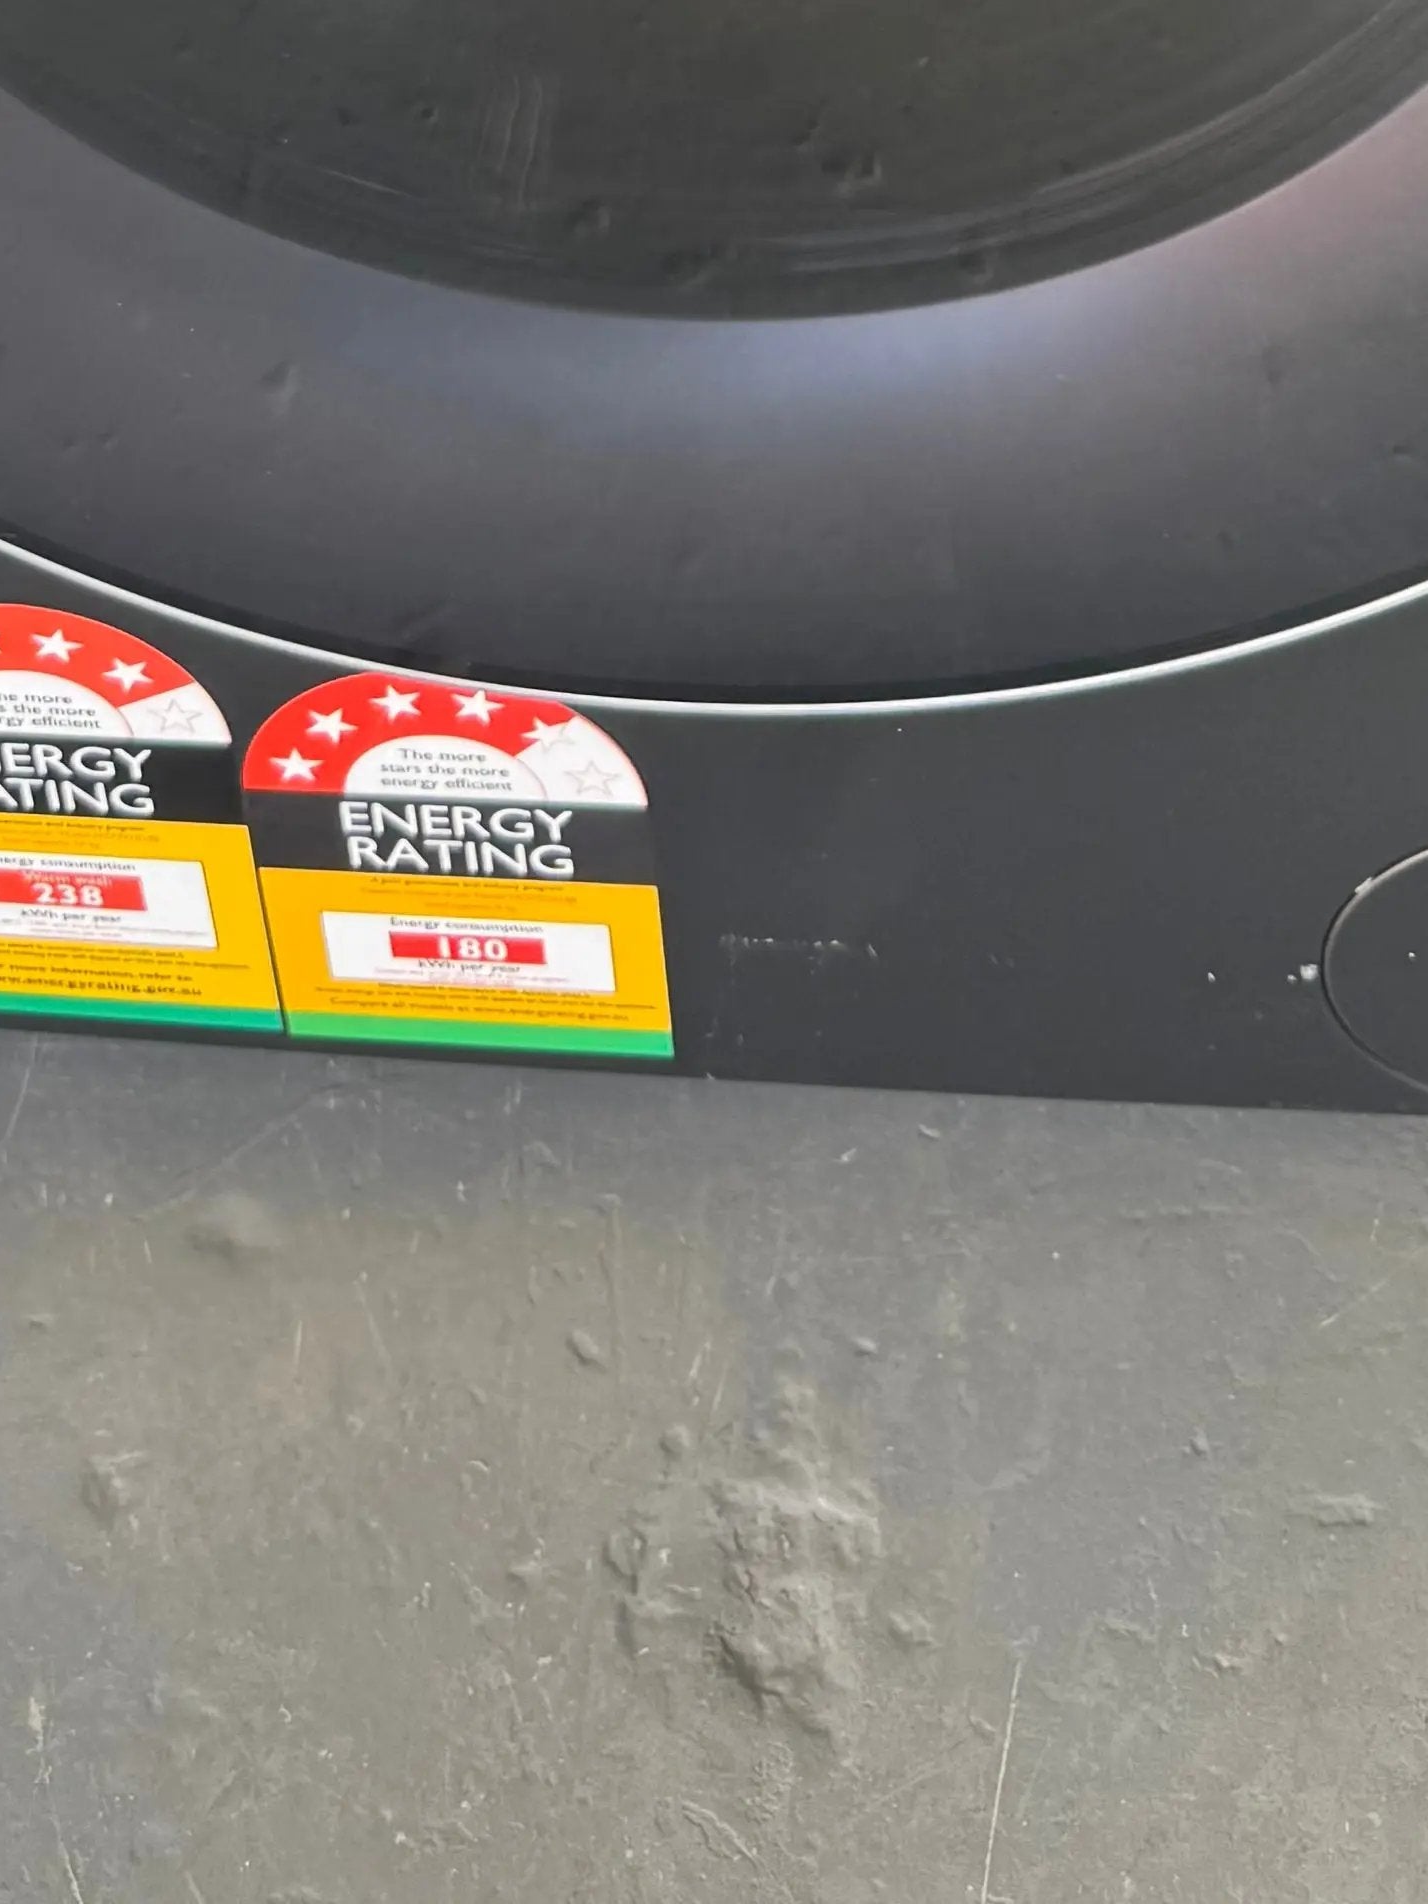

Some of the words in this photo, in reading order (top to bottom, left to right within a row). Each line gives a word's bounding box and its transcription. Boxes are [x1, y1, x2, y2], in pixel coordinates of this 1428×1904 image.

[338, 799, 574, 844] ENERGY
[346, 835, 575, 881] RATING
[31, 881, 104, 907] 238
[437, 934, 509, 962] 180
